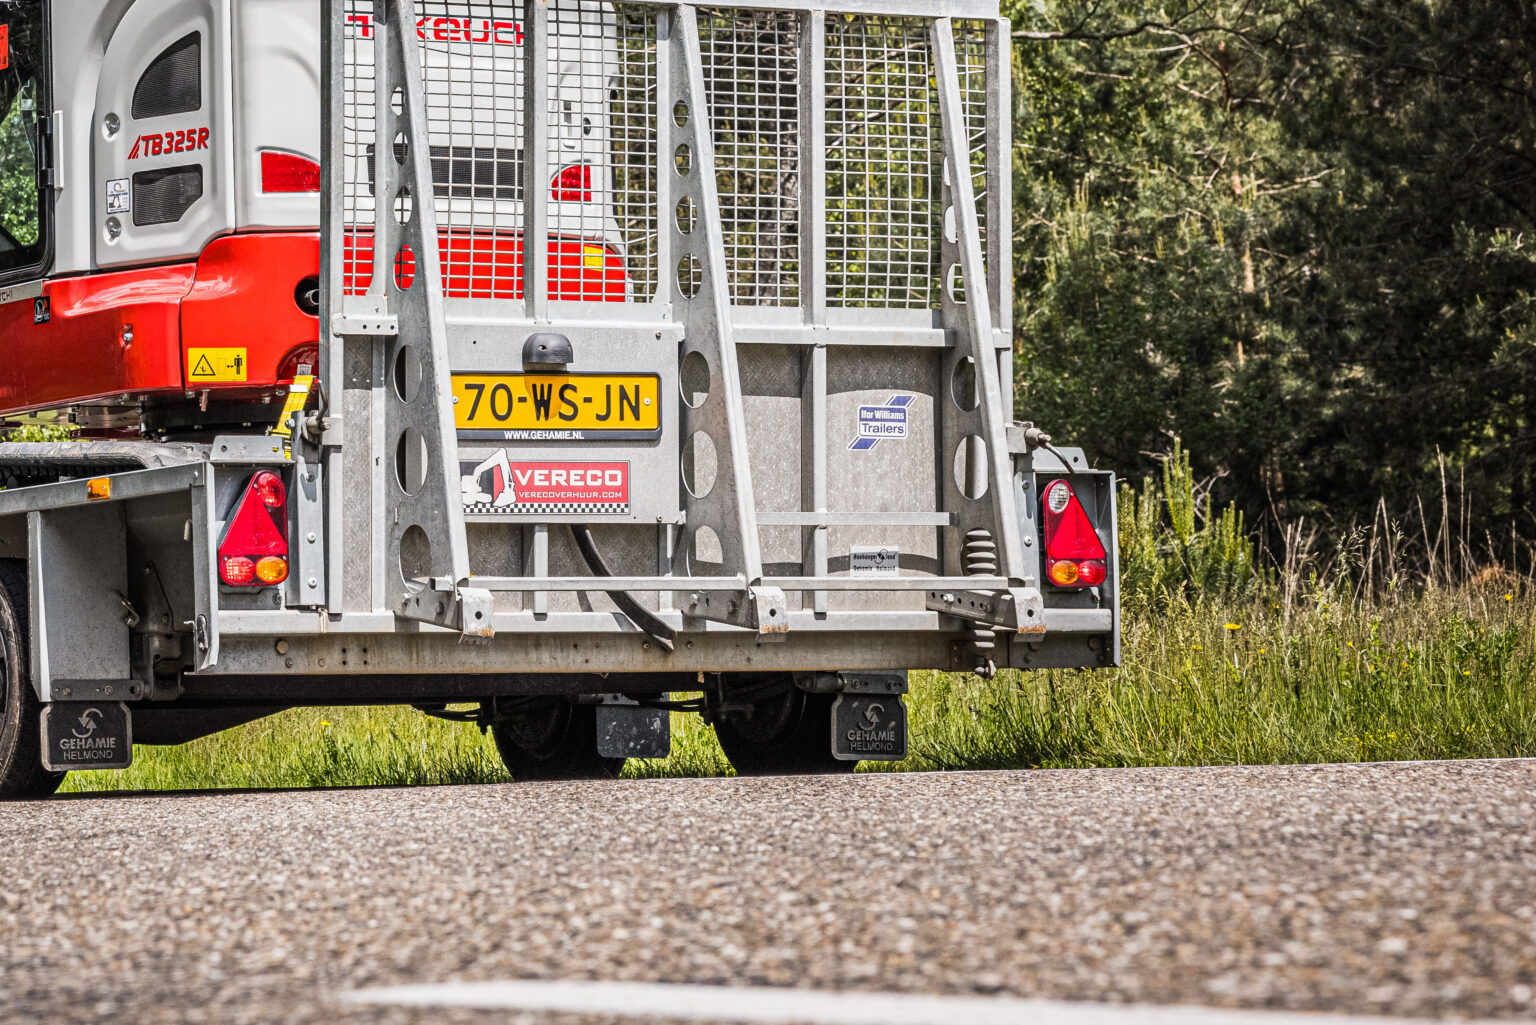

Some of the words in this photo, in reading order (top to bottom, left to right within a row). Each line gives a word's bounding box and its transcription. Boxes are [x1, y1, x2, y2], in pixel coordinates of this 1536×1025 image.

[141, 127, 209, 157] TB325R
[464, 383, 640, 422] 70-WS-JN
[874, 410, 904, 420] Williams
[862, 423, 904, 434] Trailers
[504, 431, 584, 439] WWW.GEHAMIE.NL
[515, 469, 622, 486] VERECO
[847, 730, 895, 741] GEHAMIE
[60, 737, 116, 749] GEHAMIE
[851, 742, 892, 751] HELMOND
[64, 750, 113, 760] HELMOND
